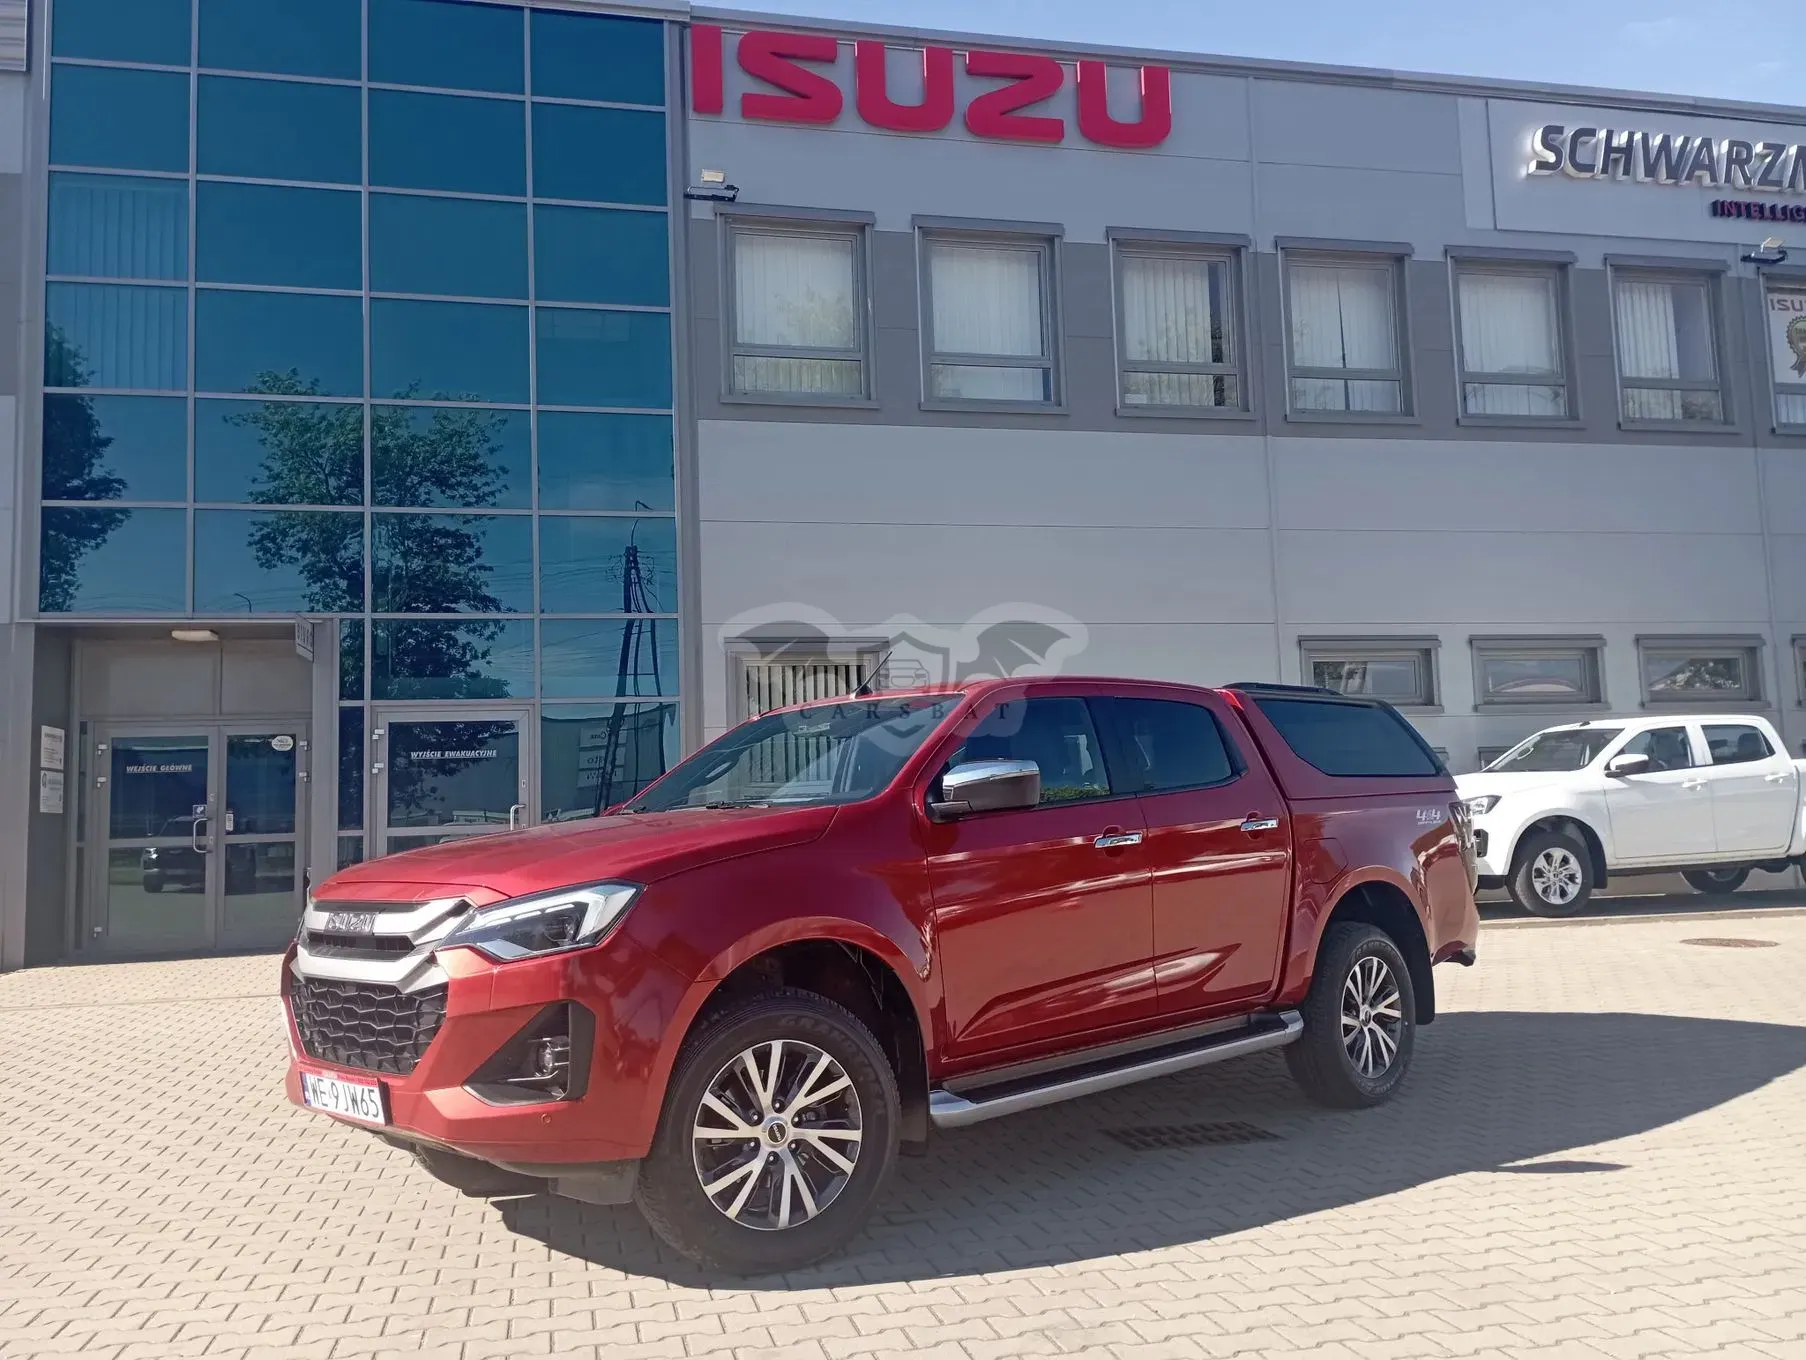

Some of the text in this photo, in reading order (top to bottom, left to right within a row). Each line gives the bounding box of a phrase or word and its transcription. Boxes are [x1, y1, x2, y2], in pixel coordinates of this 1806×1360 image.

[691, 24, 1171, 148] ISUZU
[1769, 298, 1806, 312] ISU
[410, 749, 497, 760] WYJŚCIE EWAKUACYJNE
[126, 763, 157, 773] WEJŚCIE
[308, 1076, 380, 1119] WE 9JW65
